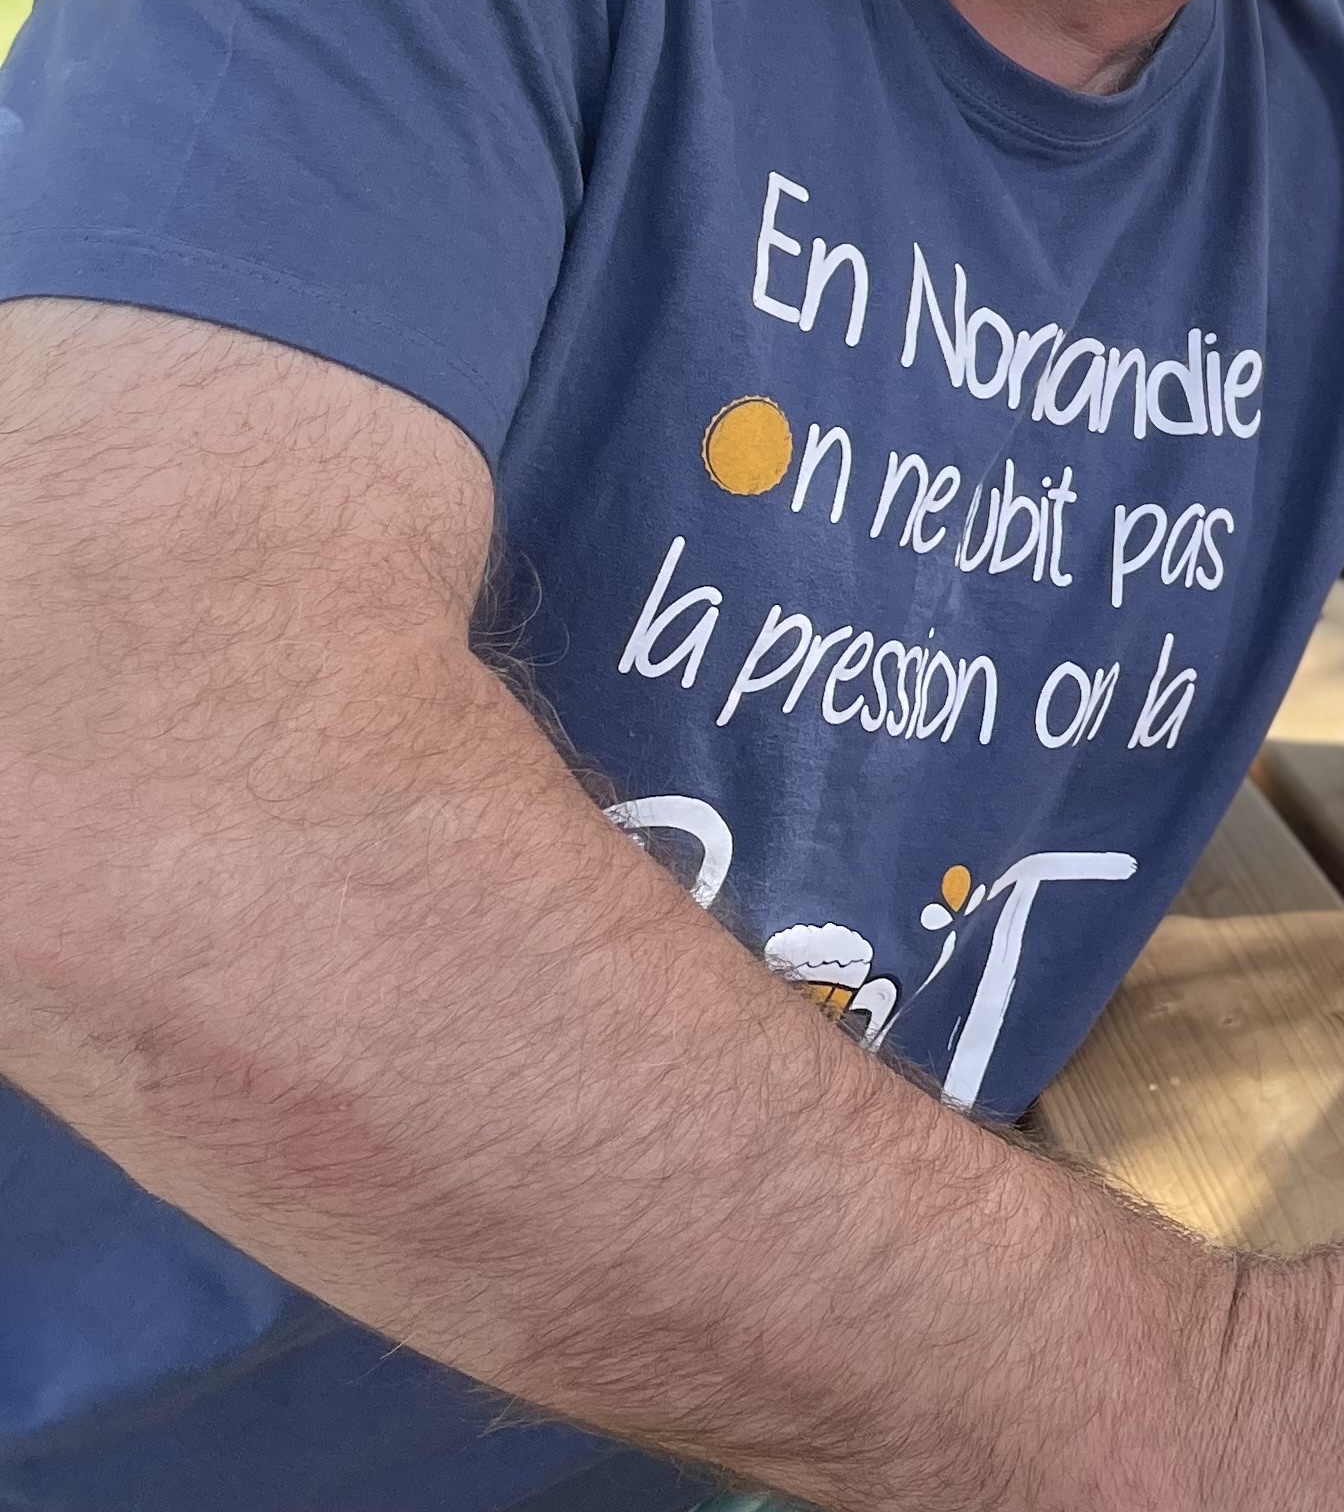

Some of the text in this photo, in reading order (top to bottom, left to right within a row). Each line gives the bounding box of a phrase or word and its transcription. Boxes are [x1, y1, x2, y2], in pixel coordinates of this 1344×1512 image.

[752, 171, 1263, 439] En Norandie
[870, 450, 961, 554] ne
[955, 458, 1078, 587] ubit
[1111, 502, 1235, 608] pas
[618, 535, 1198, 750] la pression on la
